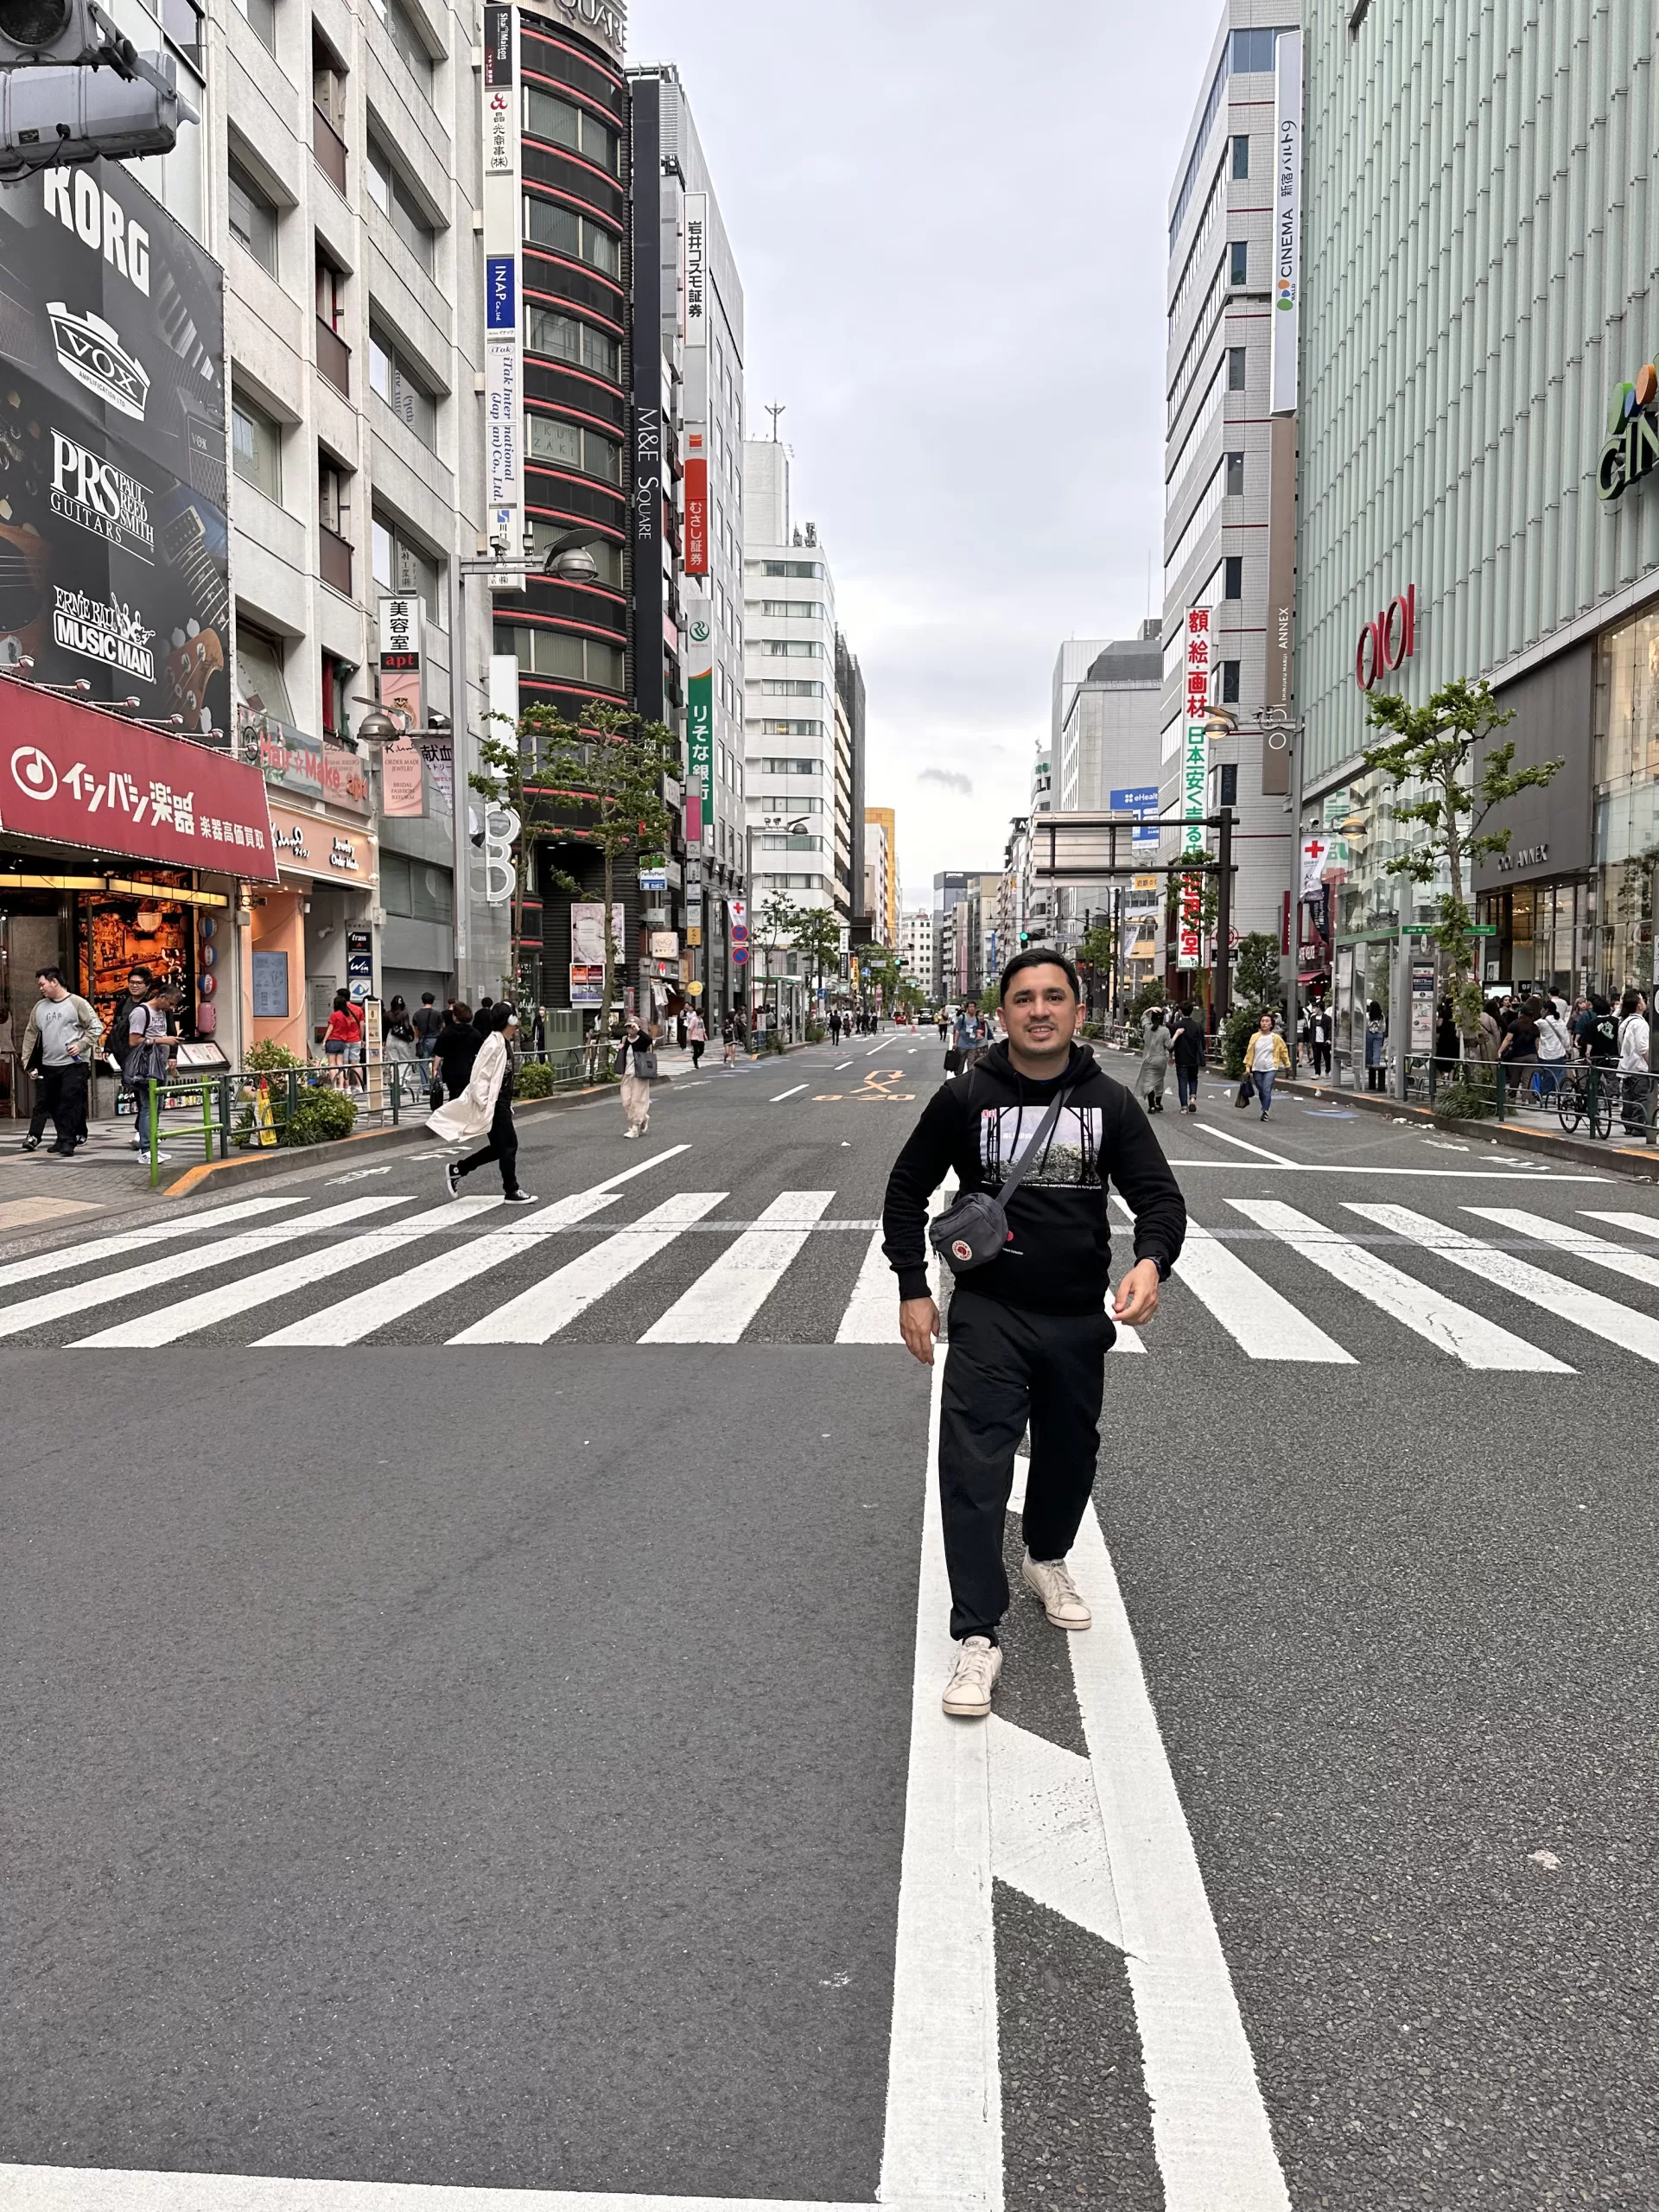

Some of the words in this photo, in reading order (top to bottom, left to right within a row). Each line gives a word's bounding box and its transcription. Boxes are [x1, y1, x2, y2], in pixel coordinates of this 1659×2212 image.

[1281, 120, 1297, 197] 新宿バルト9
[44, 166, 149, 297] KORG
[1281, 208, 1294, 277] CINEMA
[495, 265, 506, 301] INAP
[688, 220, 702, 318] 岩井コスモ証券
[61, 325, 137, 398] VOX
[503, 357, 513, 385] iTak
[638, 407, 659, 462] M&E
[51, 431, 120, 522] PRS
[493, 450, 503, 474] Co.,
[119, 471, 145, 504] PAUL
[119, 490, 148, 523] REED
[493, 476, 503, 501] Ltd.
[638, 476, 659, 540] SQUARE
[51, 493, 122, 543] GUITARS
[119, 512, 154, 544] SMITH
[690, 501, 703, 566] むさし証券
[91, 600, 118, 632] BALL
[390, 601, 409, 650] 美容室
[1279, 607, 1289, 649] ANNEX
[57, 619, 116, 661] MUSIC
[118, 640, 151, 677] MAN
[385, 654, 413, 670] apt
[1186, 609, 1210, 718] 額・絵・画材
[259, 730, 292, 772] Hair
[305, 748, 340, 789] Make
[62, 762, 195, 836] イシバシ楽器
[200, 816, 265, 851] 楽器高価買取
[334, 836, 355, 858] Jewelry
[1517, 843, 1549, 867] ANNEX
[330, 853, 346, 868] Order
[46, 1012, 62, 1021] GAP
